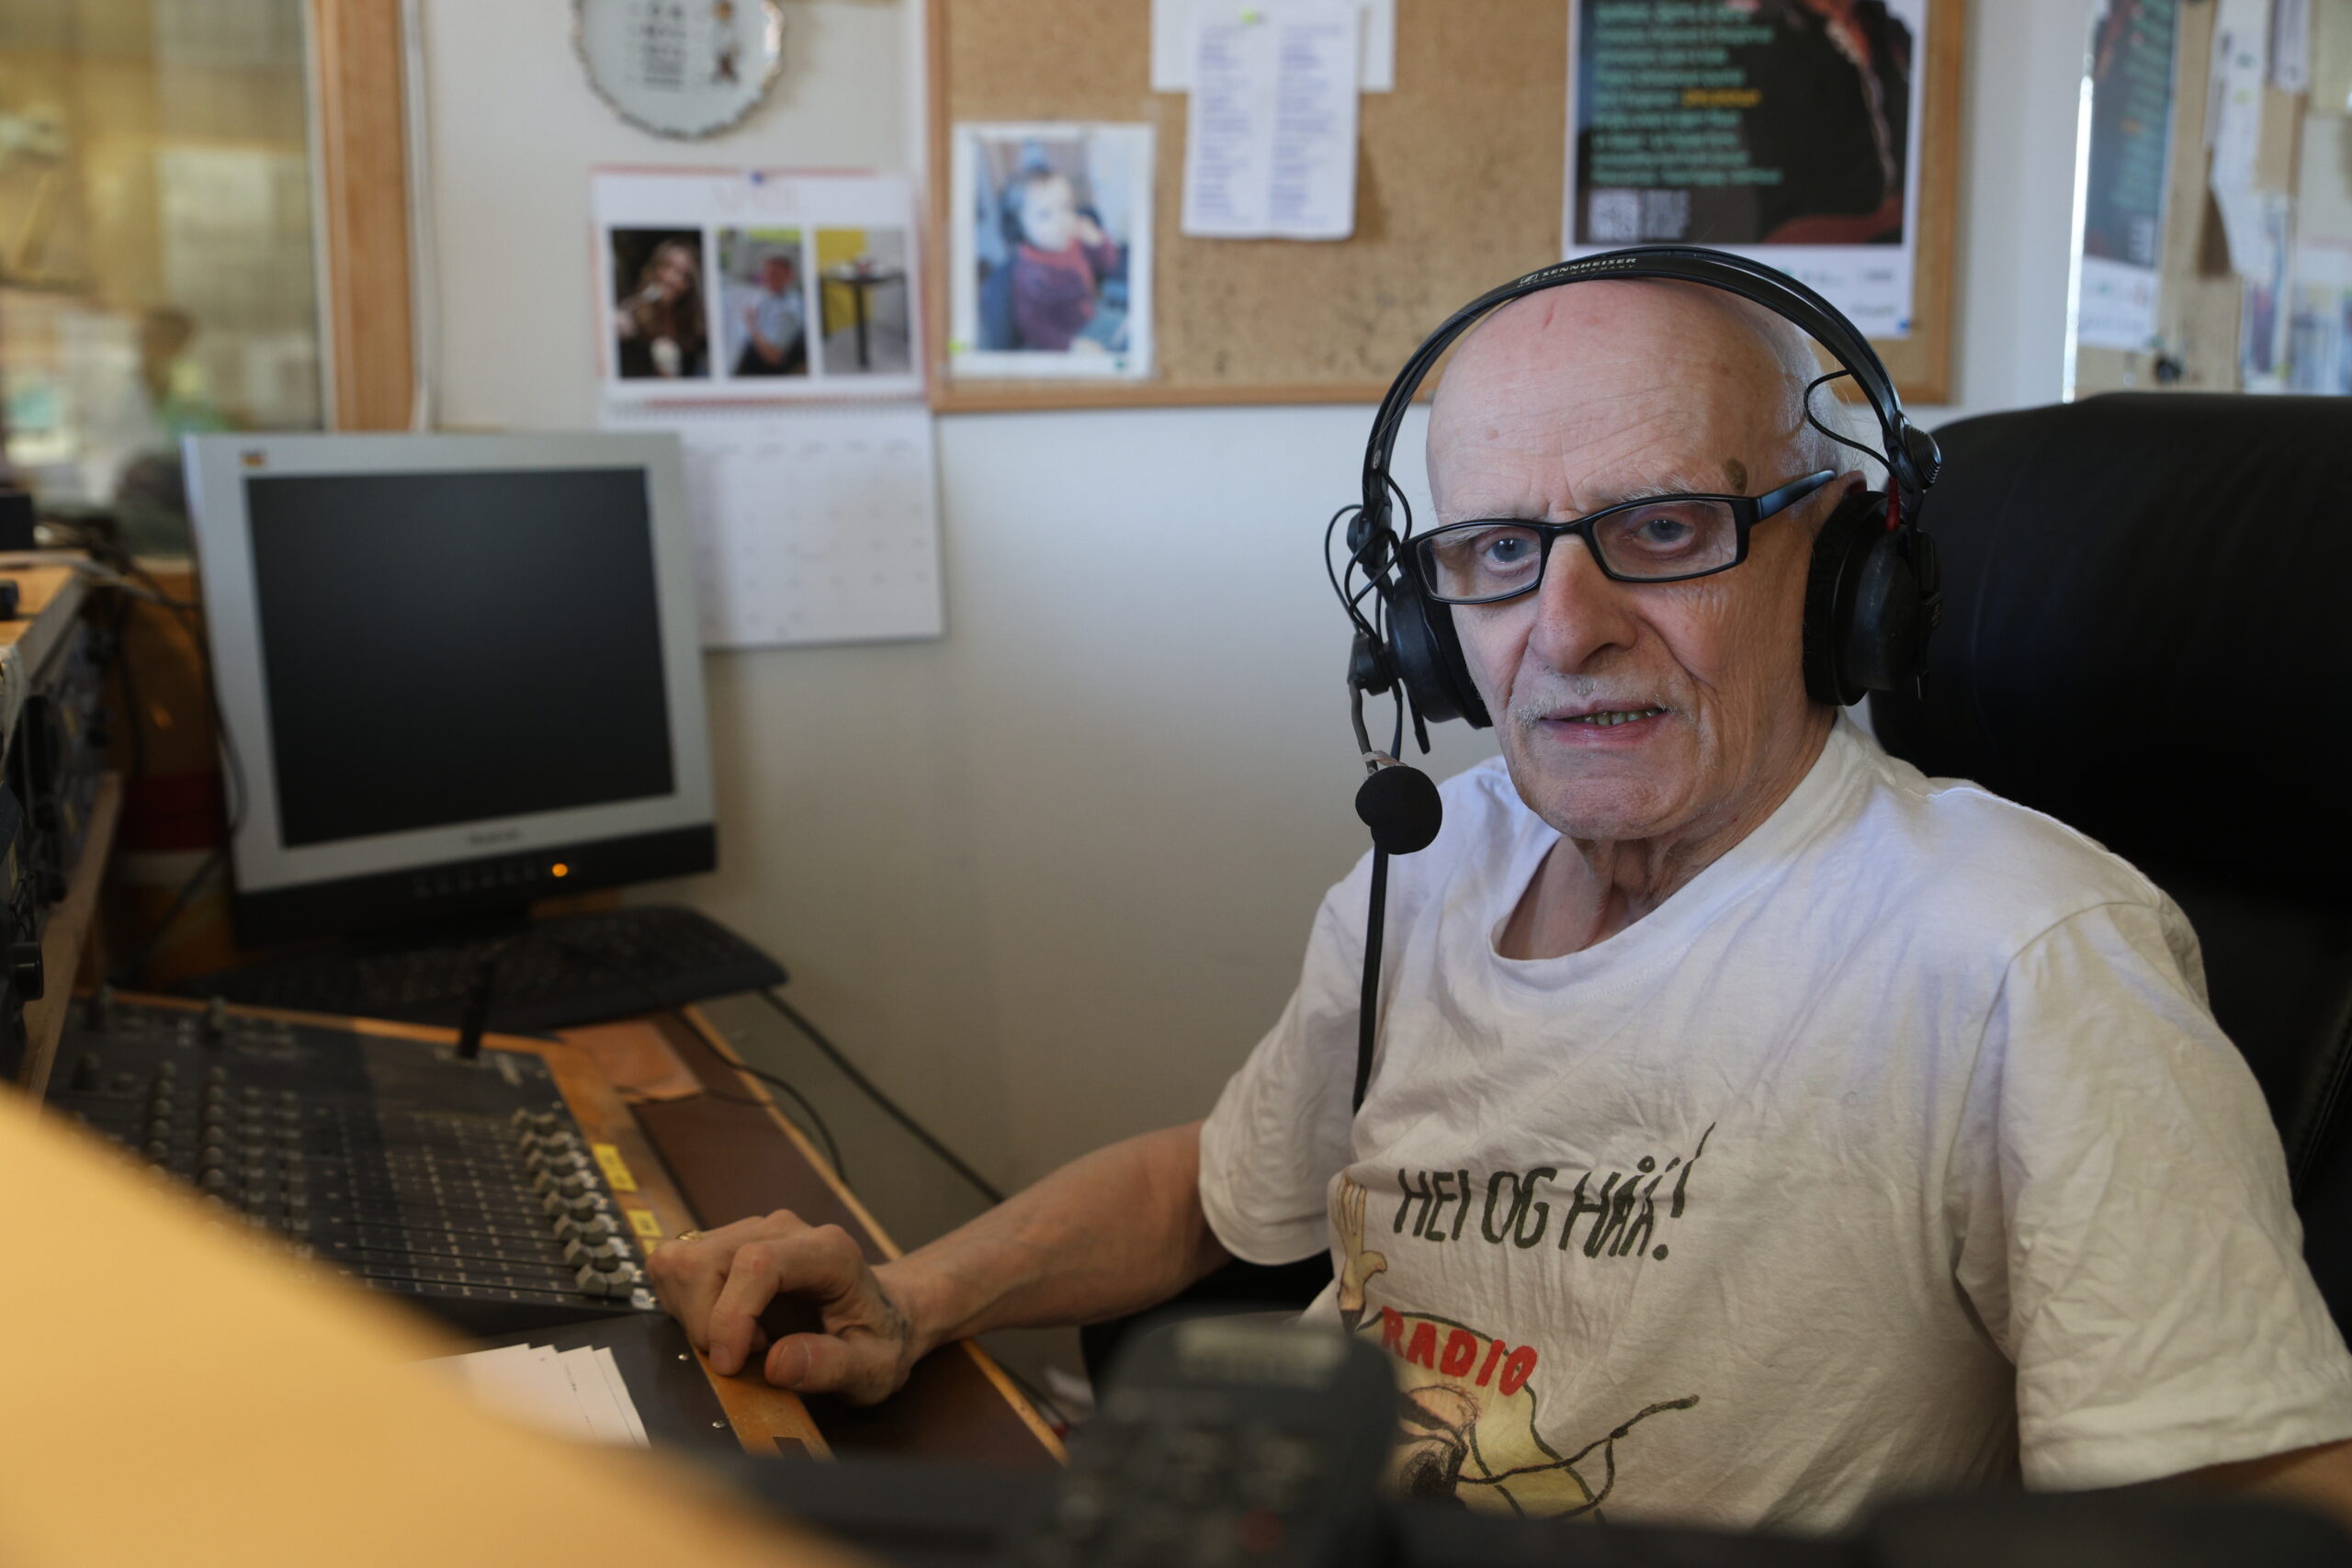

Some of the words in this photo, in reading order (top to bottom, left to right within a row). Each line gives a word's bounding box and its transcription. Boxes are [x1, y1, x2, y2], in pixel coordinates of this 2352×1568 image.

[1542, 257, 1637, 276] SENNHEISER
[1393, 1168, 1472, 1241] HEI
[1481, 1167, 1558, 1249] OG
[1382, 1305, 1538, 1397] RADIO
